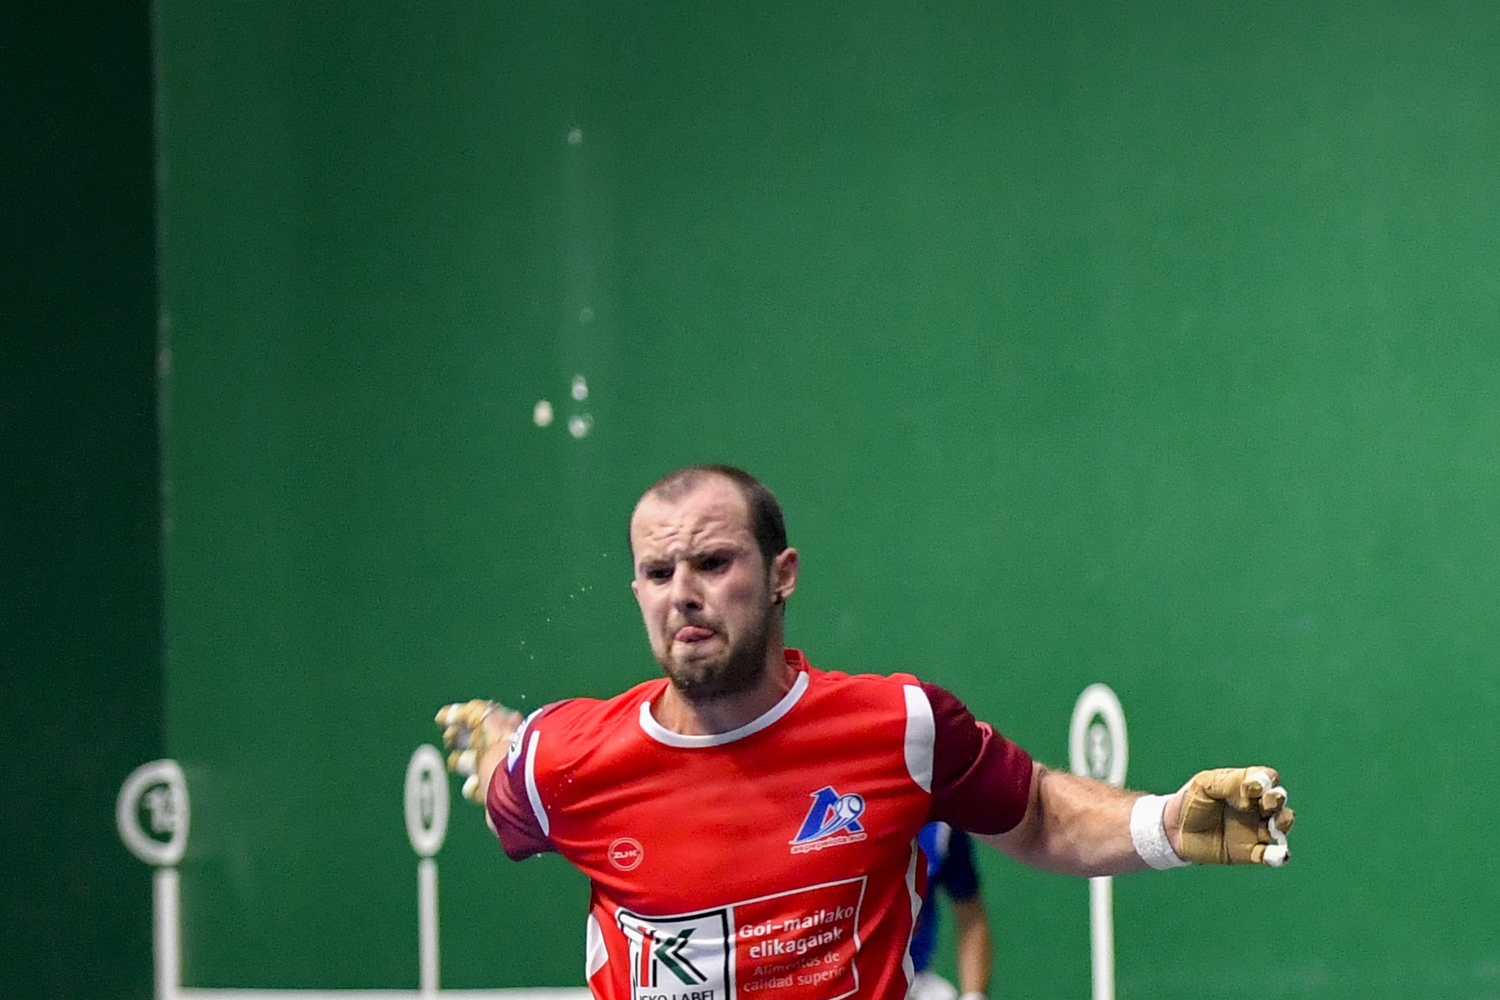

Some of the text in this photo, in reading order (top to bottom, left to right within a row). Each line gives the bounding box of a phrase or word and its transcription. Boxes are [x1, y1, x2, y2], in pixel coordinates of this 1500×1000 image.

[739, 906, 854, 938] Goi-mailako
[749, 926, 843, 958] elikagaiak
[823, 951, 840, 964] de
[743, 974, 793, 993] calidad
